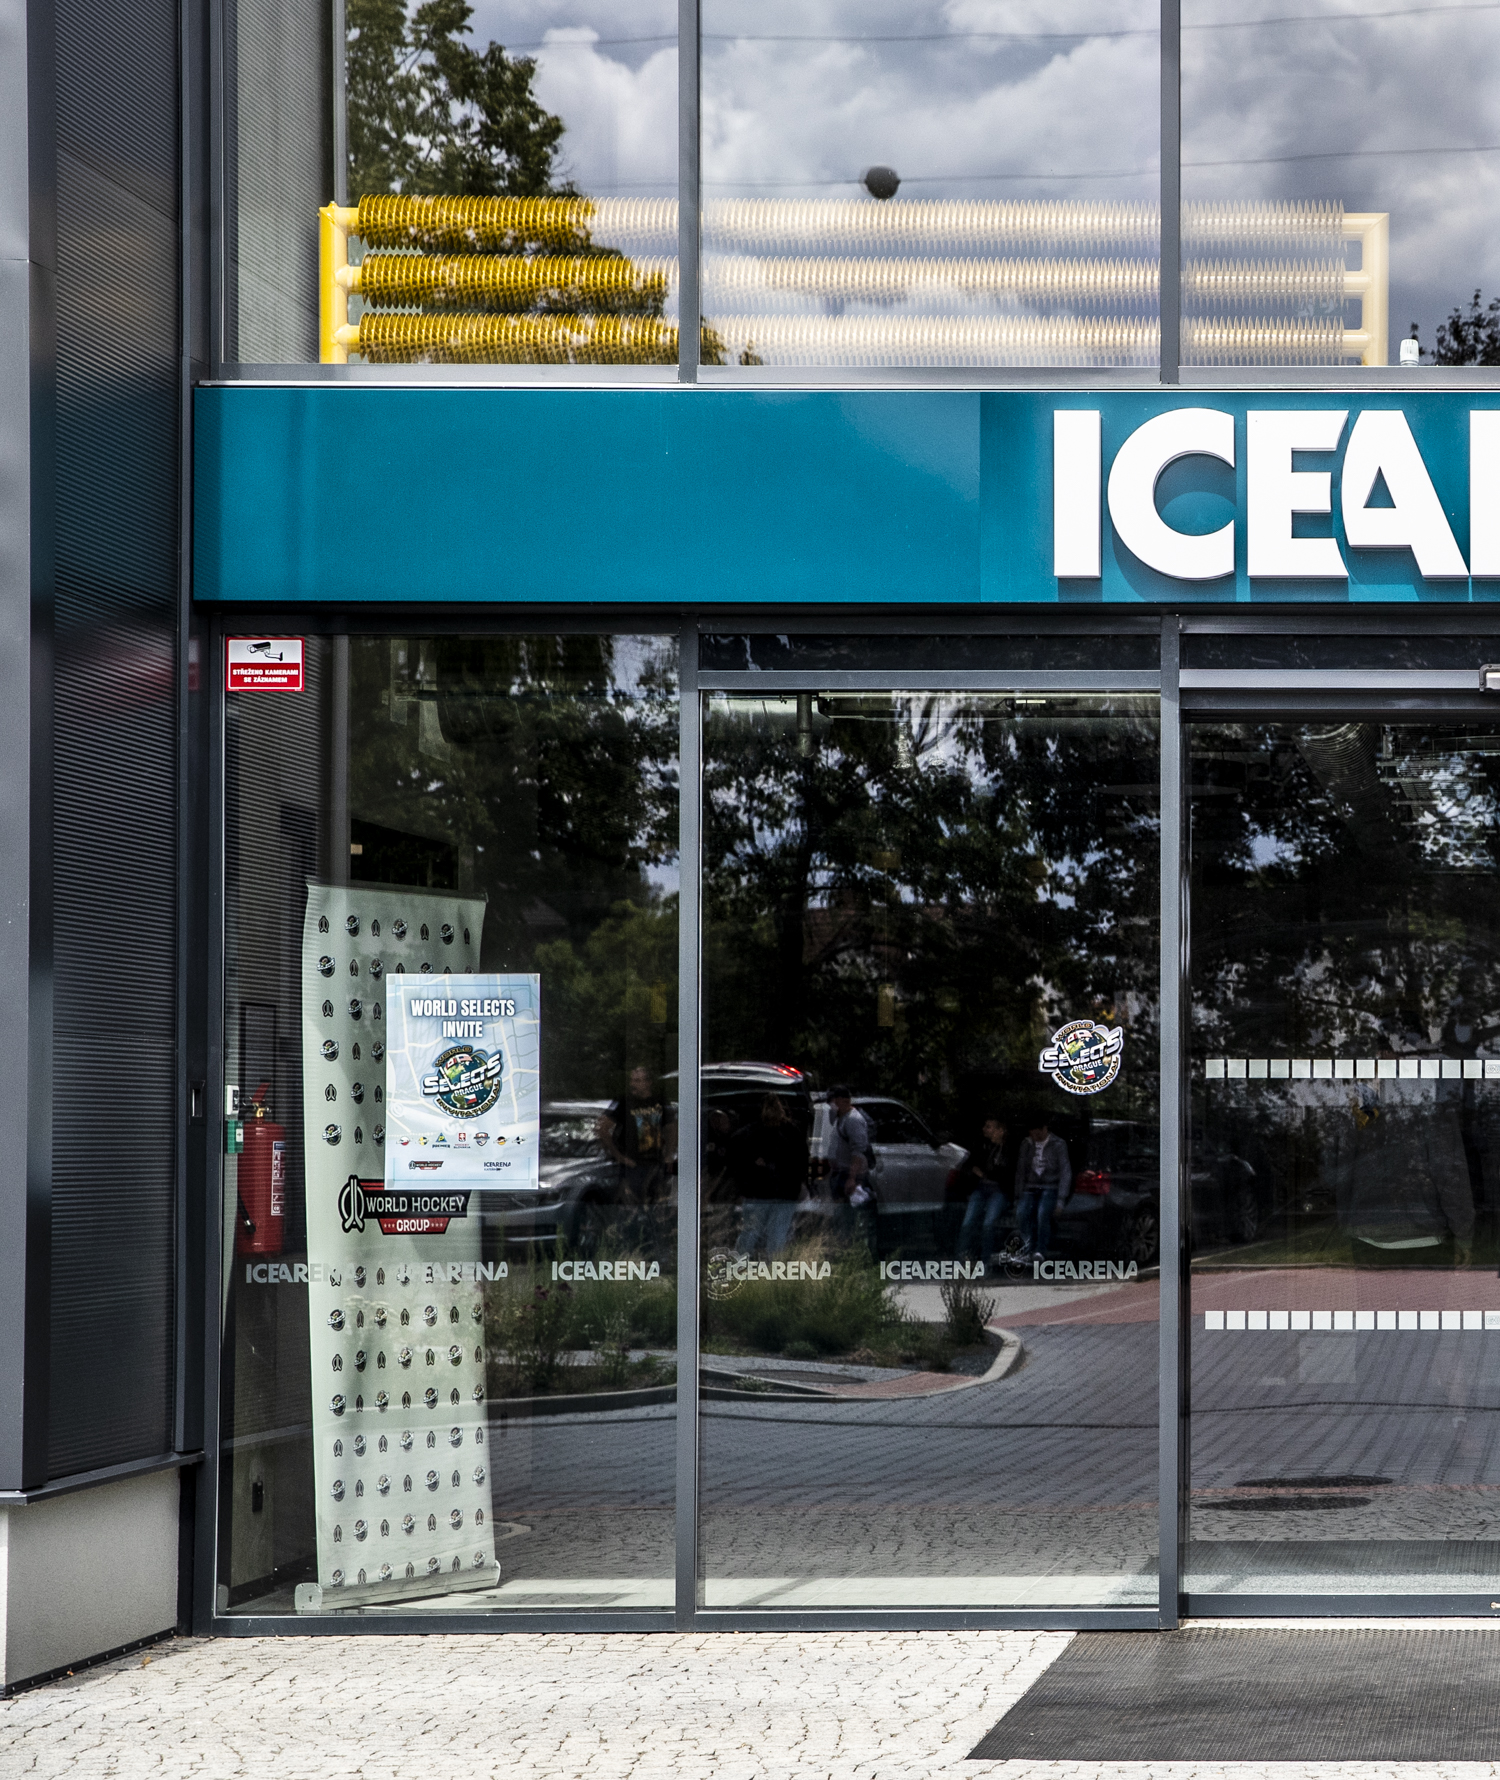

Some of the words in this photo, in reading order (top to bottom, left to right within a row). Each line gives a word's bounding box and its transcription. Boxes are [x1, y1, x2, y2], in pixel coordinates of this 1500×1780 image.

[411, 999, 457, 1016] WORLD
[460, 999, 515, 1016] SELECTS
[442, 1021, 483, 1038] INVITE
[1073, 1060, 1103, 1071] PRAGUE
[453, 1083, 484, 1097] PRAGUE
[366, 1197, 408, 1212] WORLD
[411, 1196, 465, 1212] HOCKEY
[396, 1219, 430, 1231] GROUP
[551, 1260, 660, 1280] ICEARENA
[726, 1261, 832, 1280] ICEARENA
[880, 1260, 985, 1280] ICEARENA
[1033, 1260, 1138, 1280] ICEARENA
